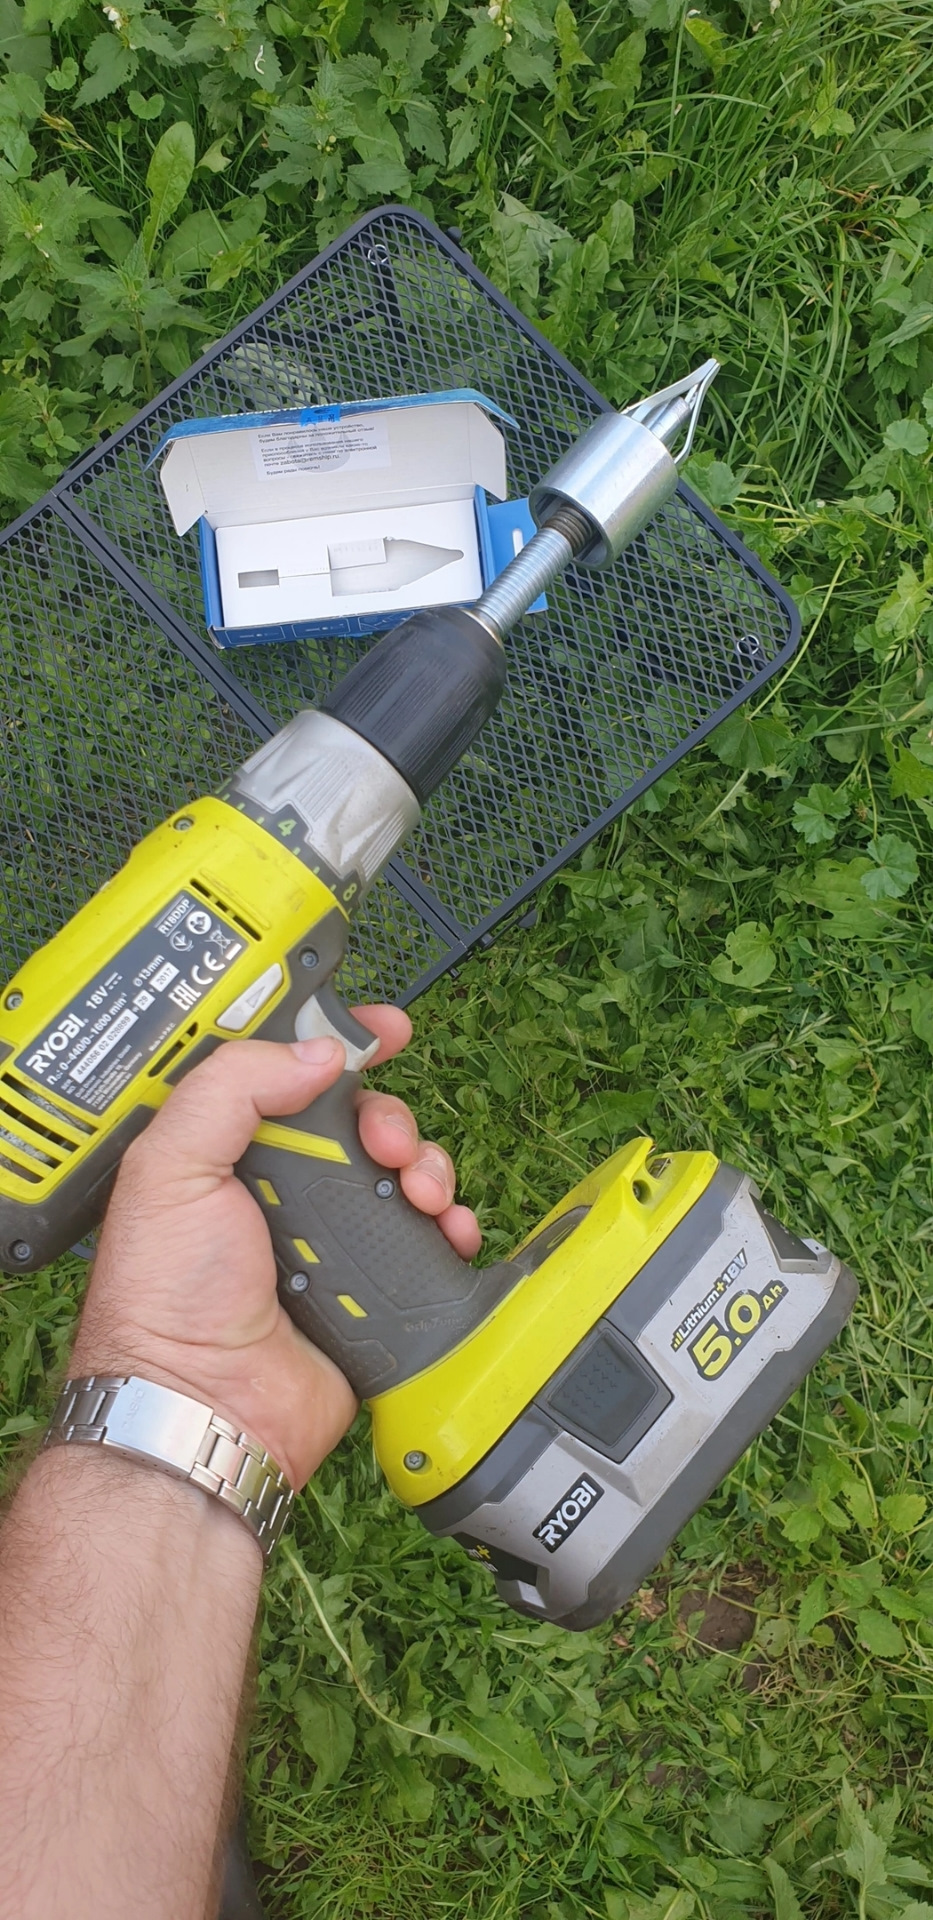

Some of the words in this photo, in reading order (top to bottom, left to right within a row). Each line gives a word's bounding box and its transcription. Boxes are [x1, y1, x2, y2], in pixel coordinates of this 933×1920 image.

[277, 818, 298, 837] 4
[157, 898, 190, 935] R18DDP
[342, 882, 358, 902] 8
[25, 1012, 86, 1074] RYOBI
[85, 985, 108, 1009] 18V
[98, 1041, 109, 1051] 02
[156, 967, 174, 985] 2017
[691, 1293, 761, 1377] 5.0
[761, 1283, 783, 1311] Ah
[537, 1480, 598, 1547] RYOBI
